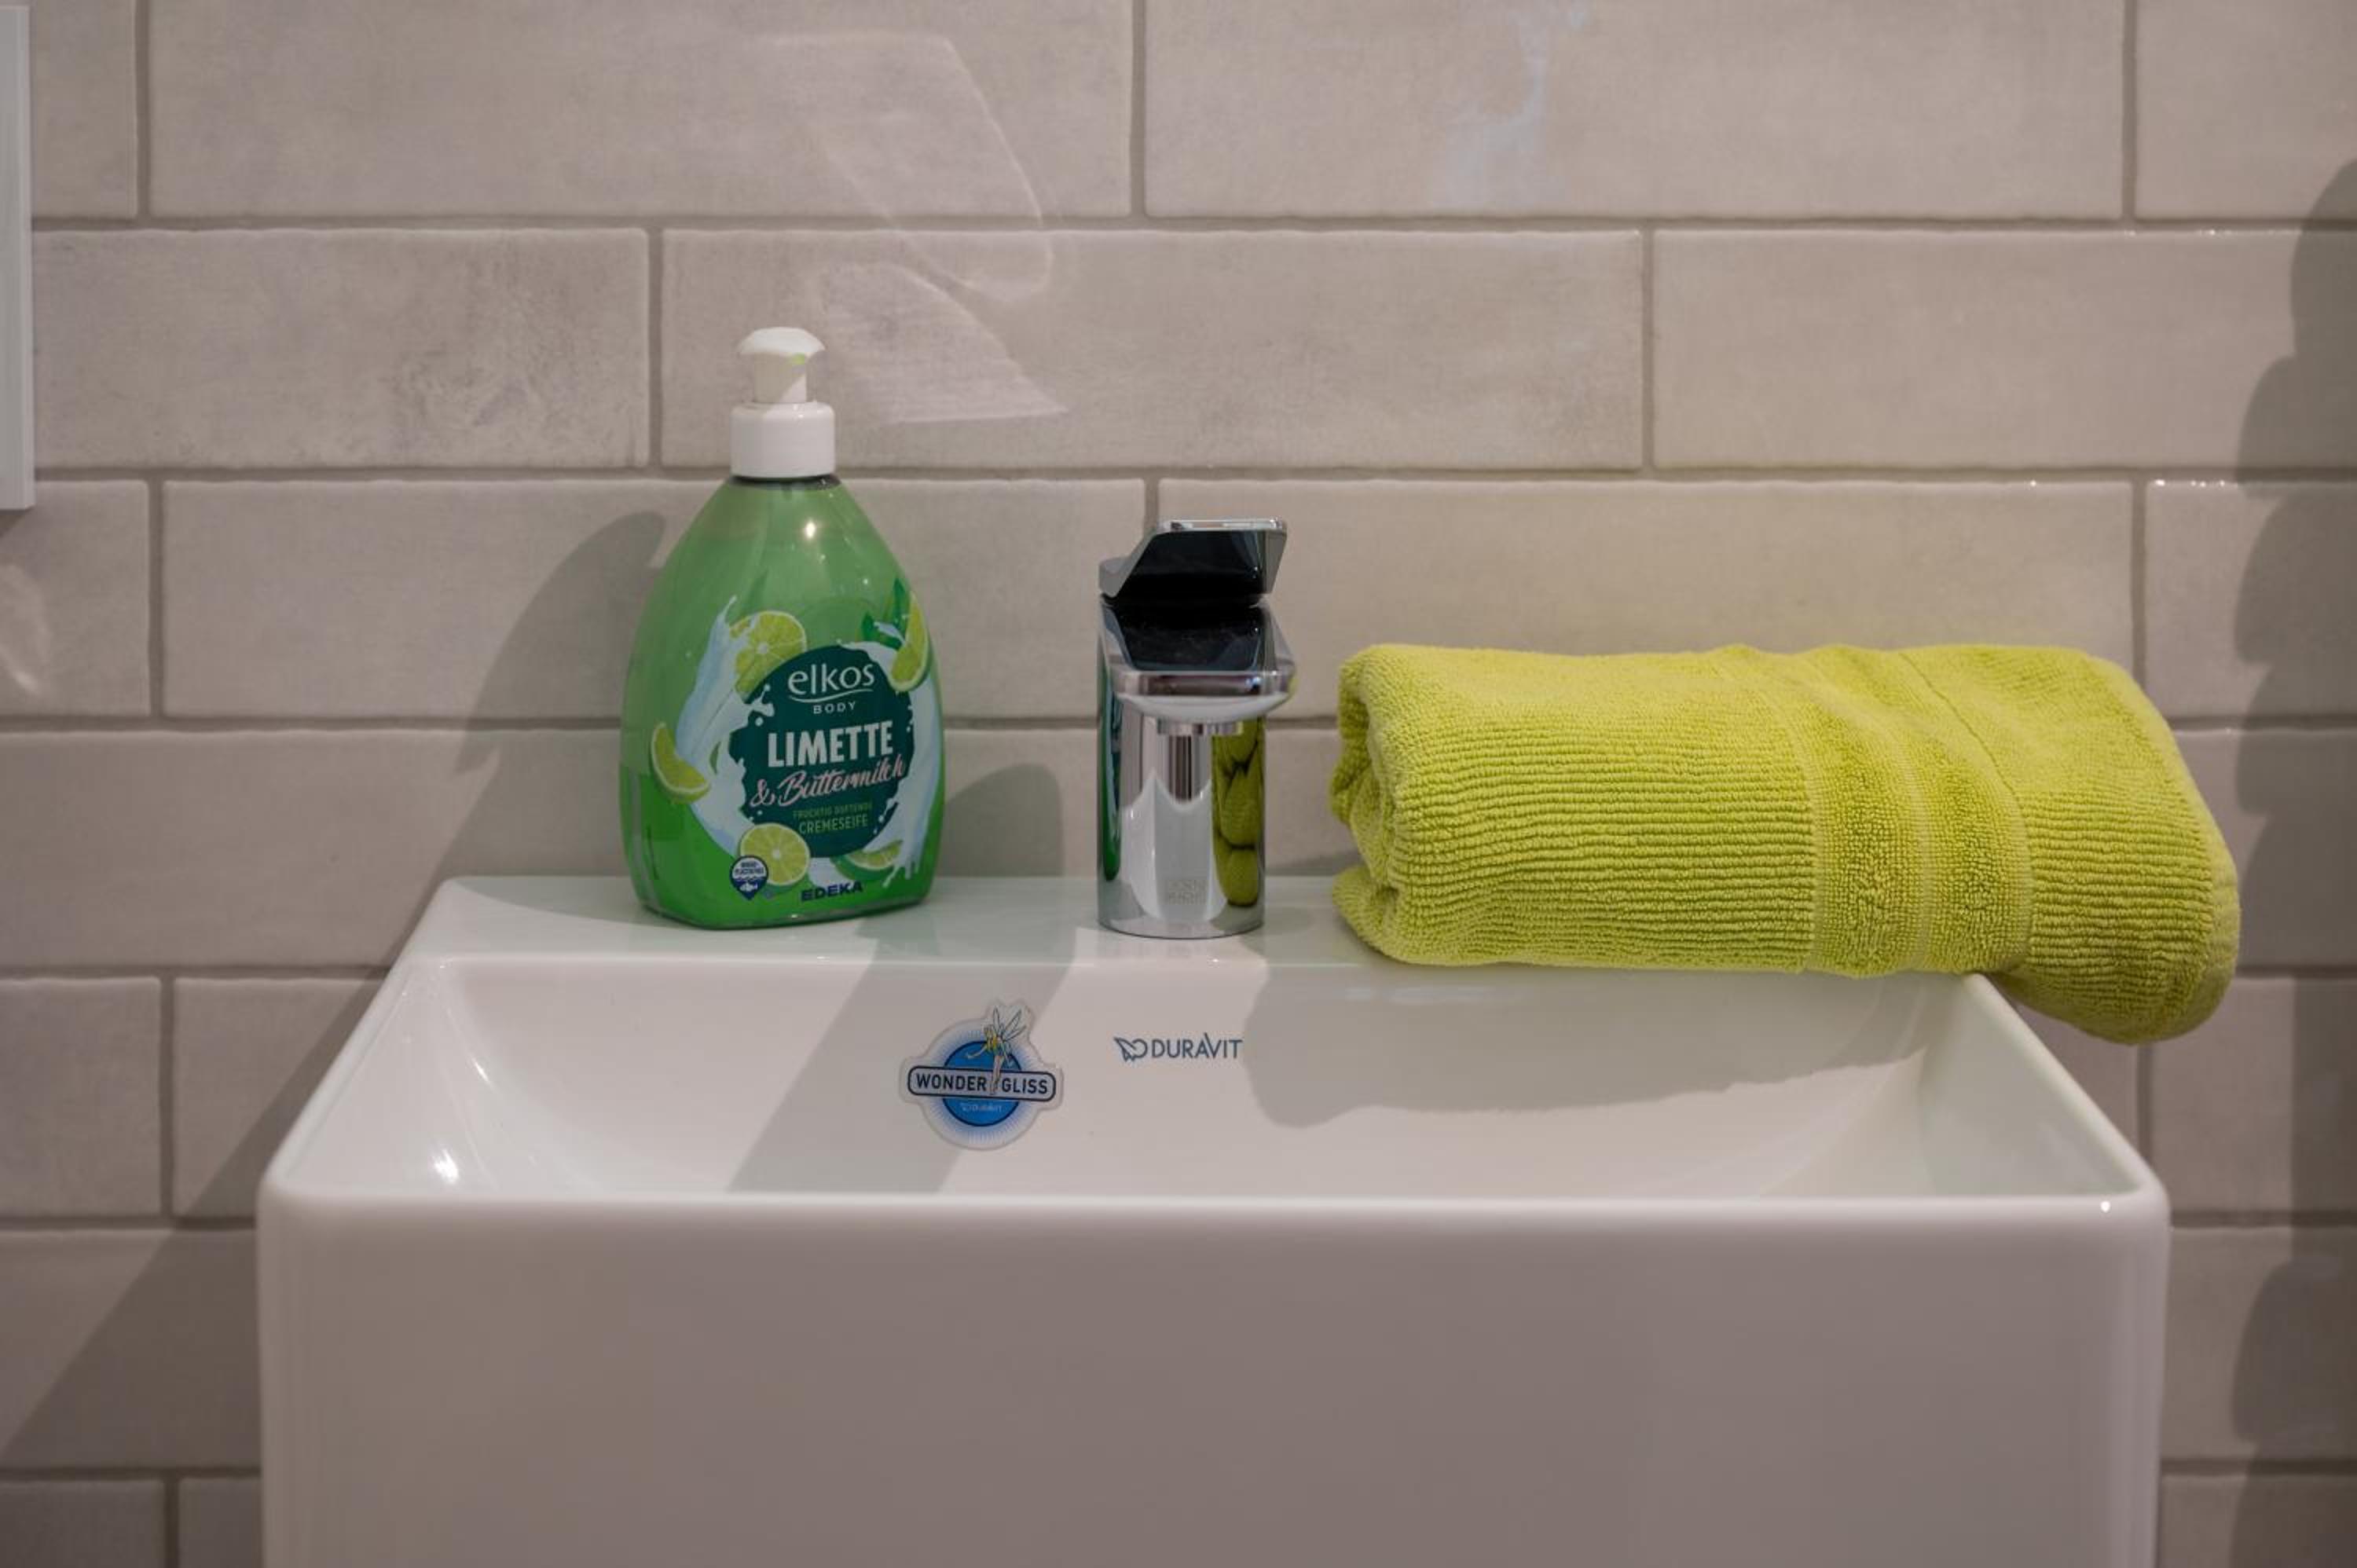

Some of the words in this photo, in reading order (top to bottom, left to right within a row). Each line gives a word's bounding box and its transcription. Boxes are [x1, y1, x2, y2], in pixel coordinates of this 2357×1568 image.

[788, 662, 874, 695] elkos
[813, 701, 856, 715] BODY
[768, 720, 893, 768] LIMETTE
[750, 779, 775, 807] &
[778, 753, 905, 806] Buttermilch
[799, 813, 868, 834] CREMESEIFE
[801, 881, 863, 902] EDEKA
[1152, 1032, 1243, 1059] DURAVIT
[916, 1073, 987, 1092] WONDER
[1001, 1077, 1048, 1094] GLISS
